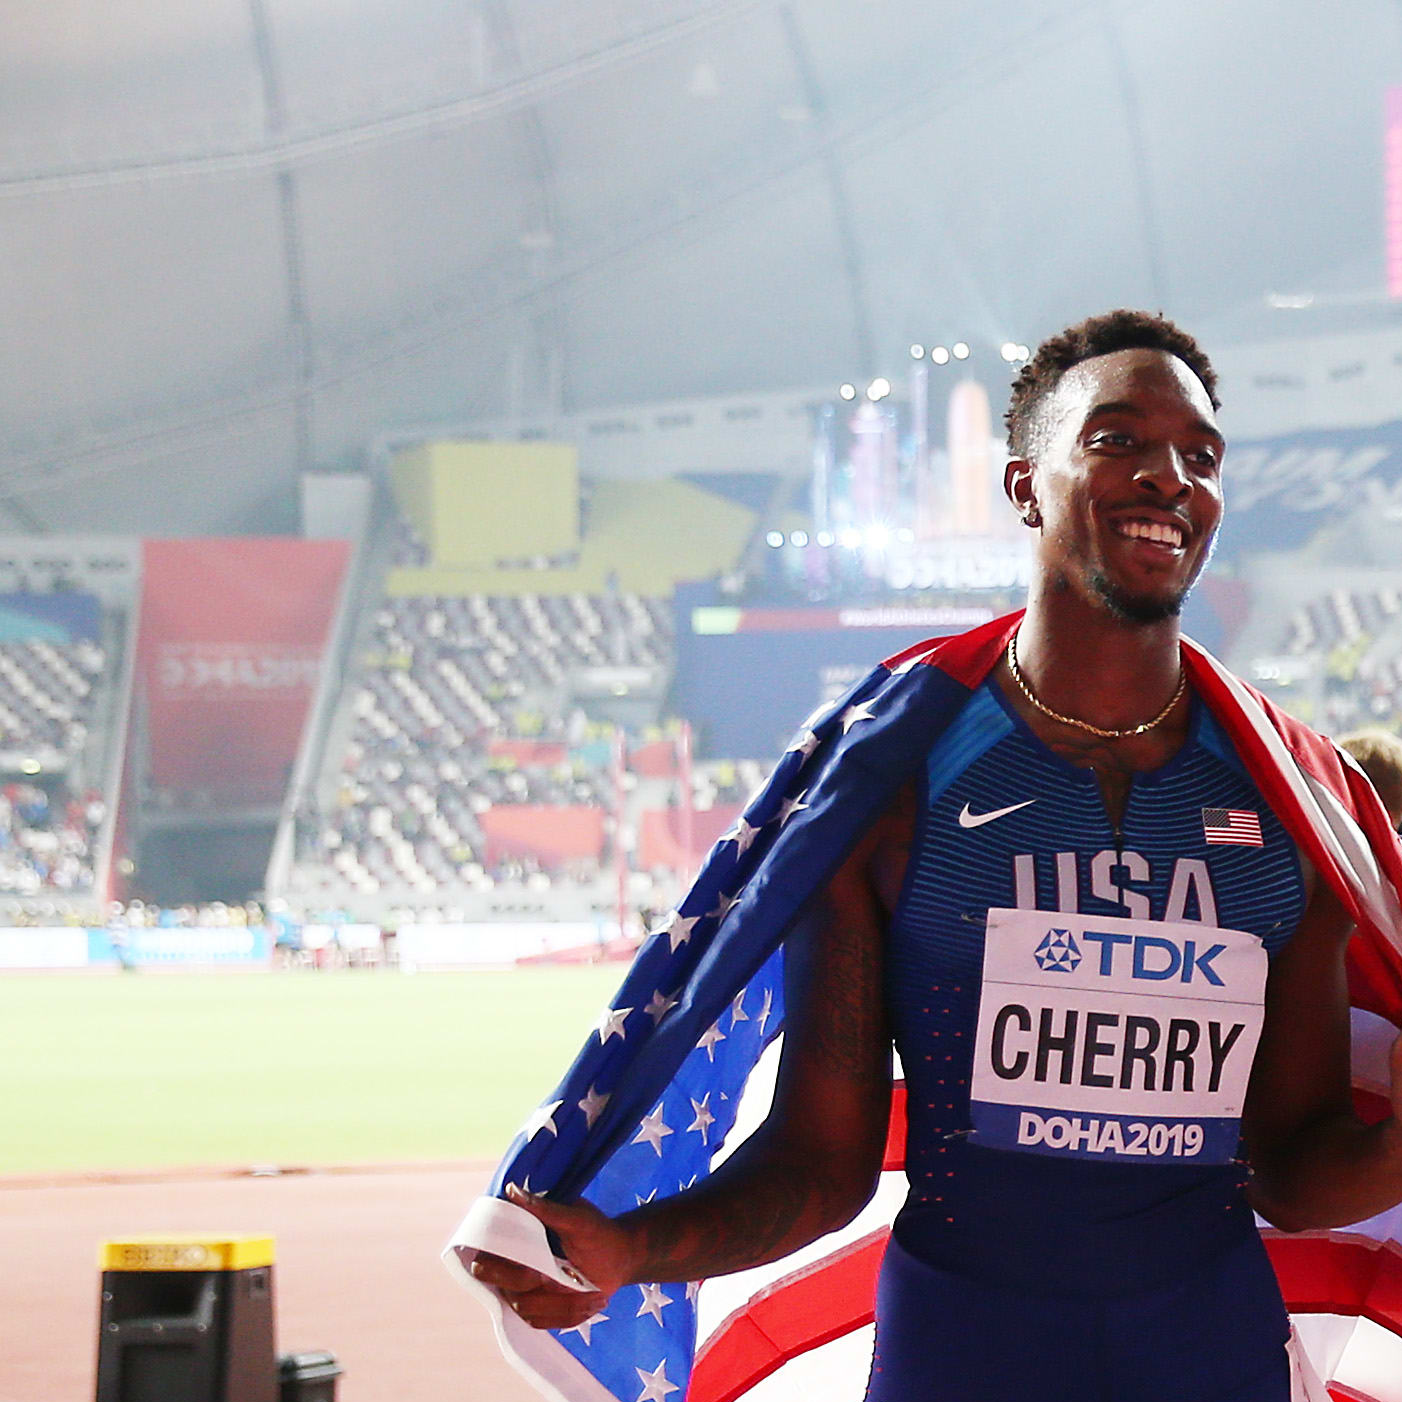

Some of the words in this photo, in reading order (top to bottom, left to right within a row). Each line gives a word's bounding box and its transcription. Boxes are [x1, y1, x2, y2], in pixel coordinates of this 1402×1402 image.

[1013, 850, 1218, 928] USA
[1083, 930, 1227, 987] TDK
[991, 1003, 1245, 1093] CHERRY
[1017, 1112, 1204, 1157] DOHA2019
